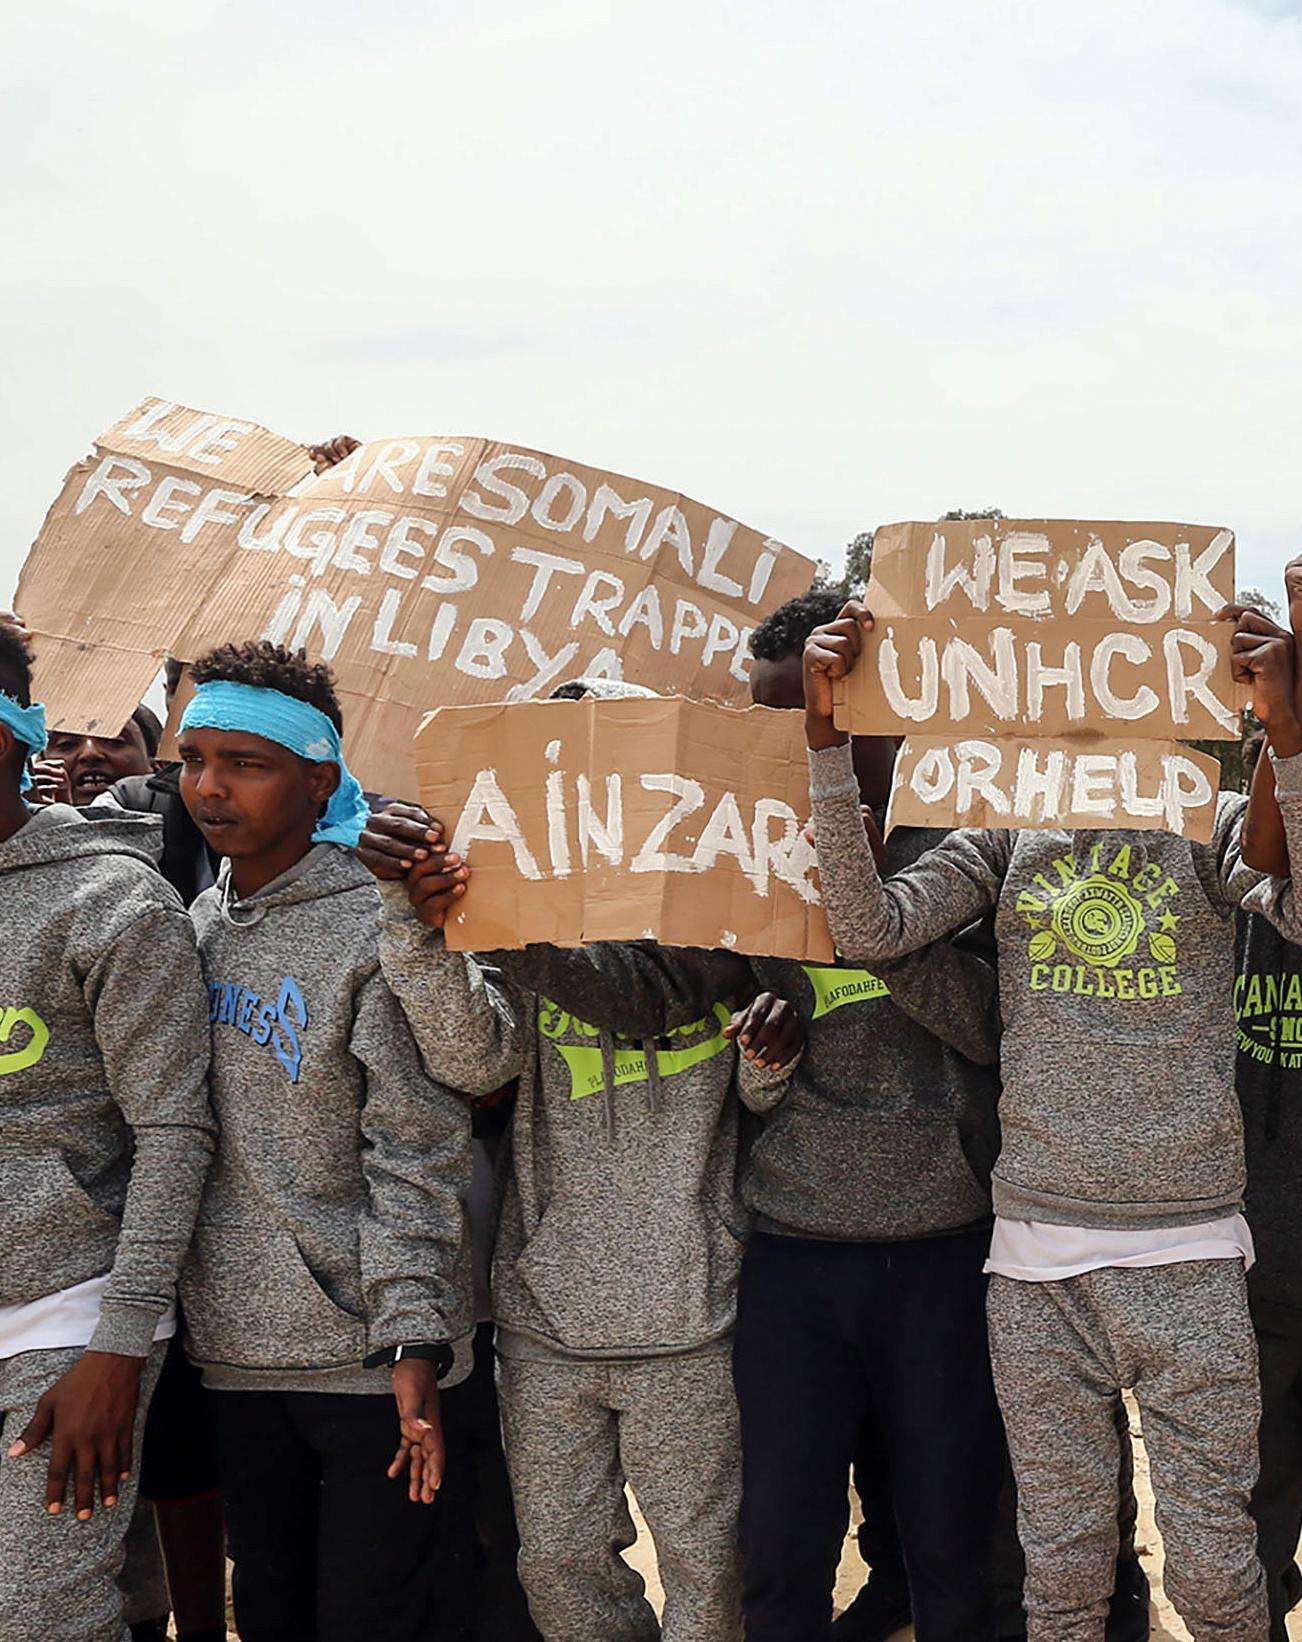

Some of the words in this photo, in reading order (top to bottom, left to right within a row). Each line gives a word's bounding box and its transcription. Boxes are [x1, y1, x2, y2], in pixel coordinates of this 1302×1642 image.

[122, 401, 251, 465] WE
[300, 441, 465, 498] ARE
[75, 455, 495, 594] REFUGEES
[510, 546, 755, 684] TRAPPE
[1065, 529, 1235, 624] ASK
[878, 626, 1242, 737] UNHCR
[1014, 747, 1212, 836] HELP
[1015, 841, 1180, 912] VINTAGE
[1029, 963, 1182, 1000] COLLEGE
